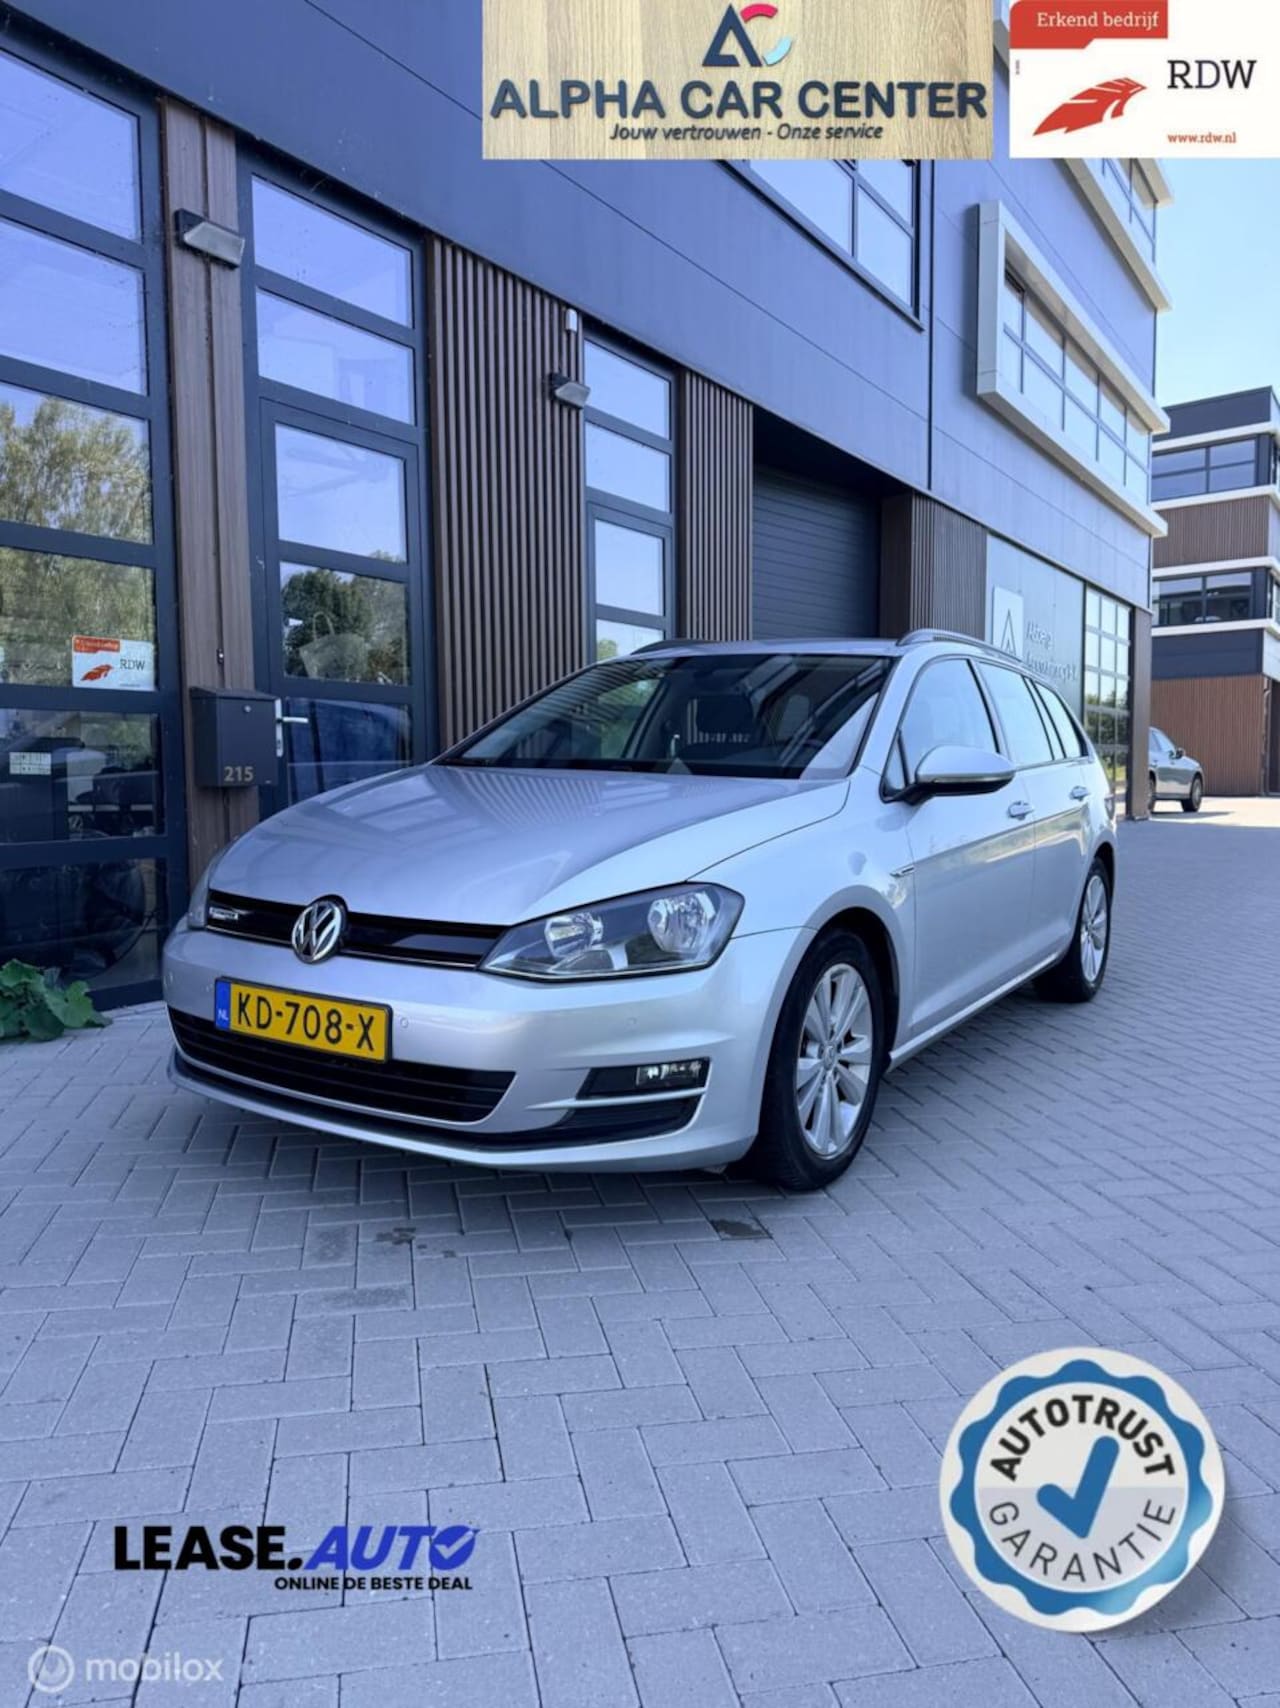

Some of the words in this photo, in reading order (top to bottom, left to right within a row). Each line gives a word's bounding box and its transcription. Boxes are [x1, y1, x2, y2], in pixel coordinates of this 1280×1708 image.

[120, 658, 145, 671] RDW
[224, 766, 254, 781] 215
[217, 1010, 229, 1021] NL
[238, 992, 374, 1051] KD-708-X
